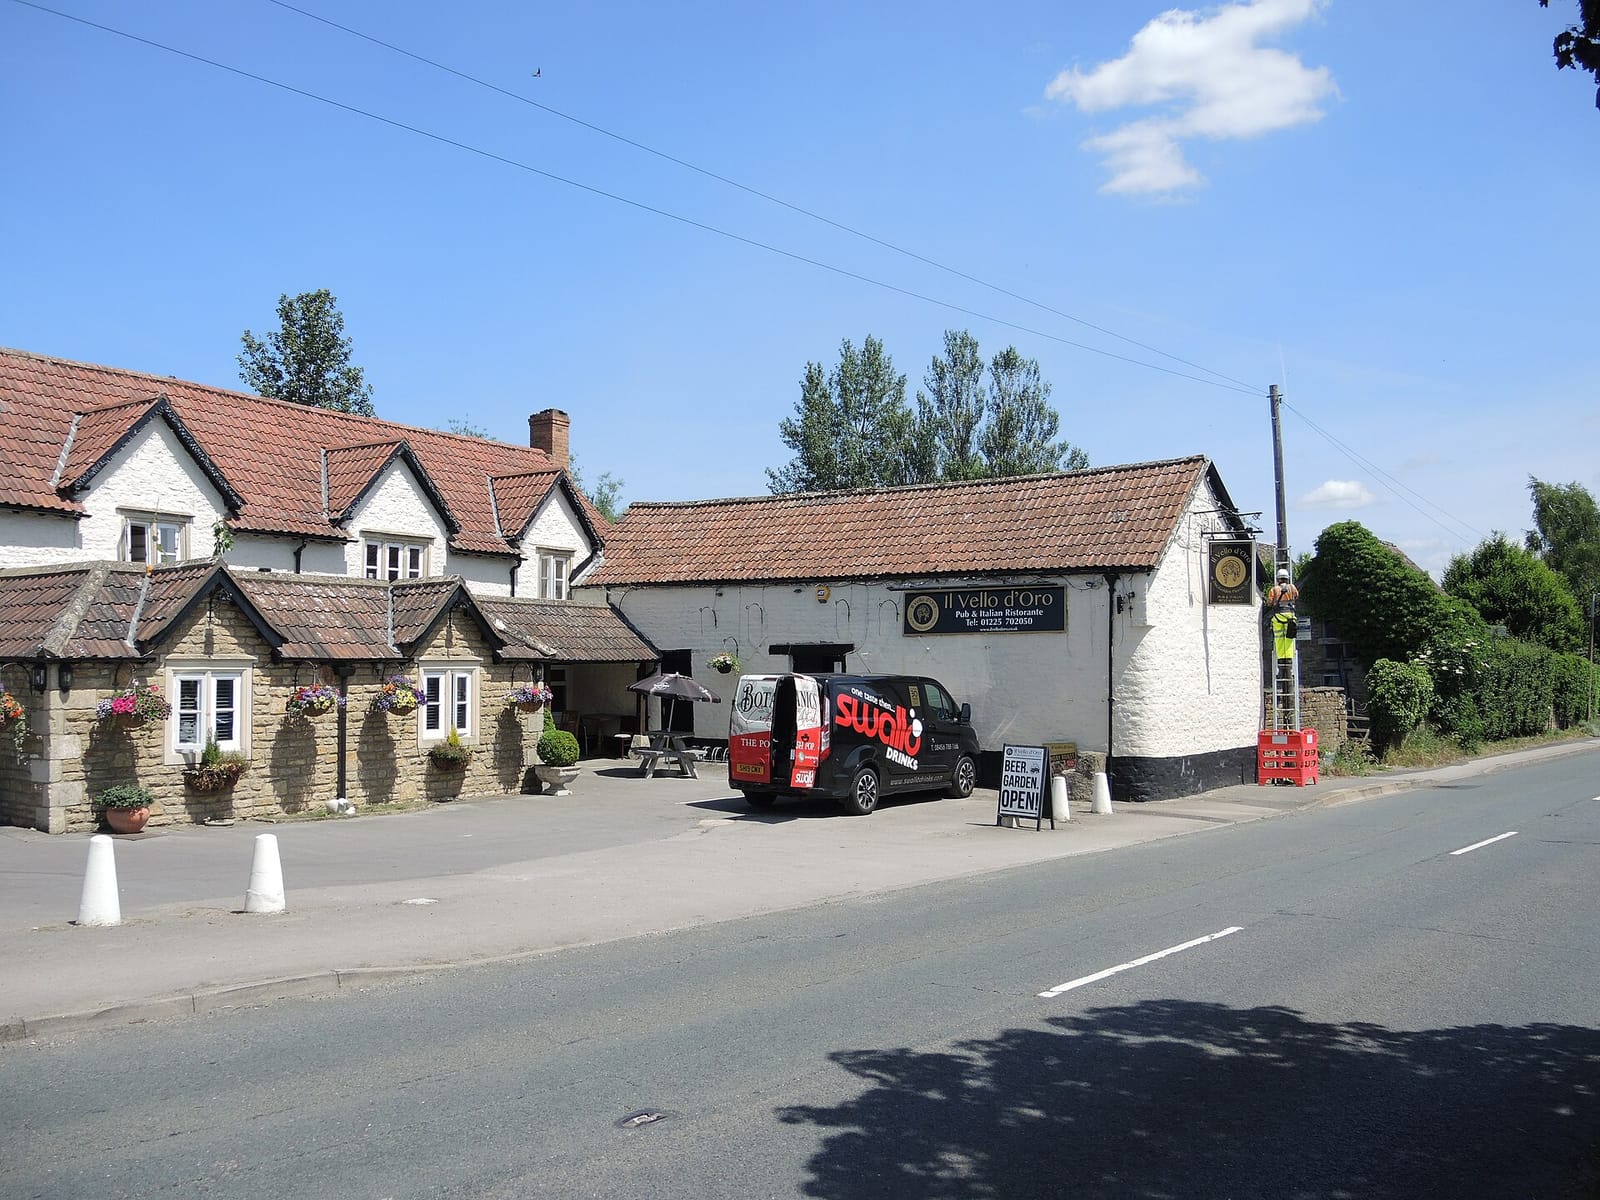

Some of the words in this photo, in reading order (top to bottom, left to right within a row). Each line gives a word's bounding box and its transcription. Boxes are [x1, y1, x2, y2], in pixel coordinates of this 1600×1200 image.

[944, 593, 953, 609] Il
[958, 591, 999, 608] Vello
[1004, 590, 1053, 607] d'Oro
[955, 610, 970, 618] Pub
[979, 609, 1003, 617] Italian
[1005, 608, 1044, 617] Ristorante
[966, 618, 978, 627] Tel:
[981, 618, 1002, 626] 01225
[1005, 617, 1033, 625] 702050
[851, 687, 863, 698] one
[864, 691, 878, 704] taste
[741, 738, 757, 747] THE
[885, 746, 919, 771] DRINKS
[1004, 760, 1028, 774] BEER.
[1003, 774, 1039, 790] GARDEN.
[1001, 789, 1039, 811] OPEN!
